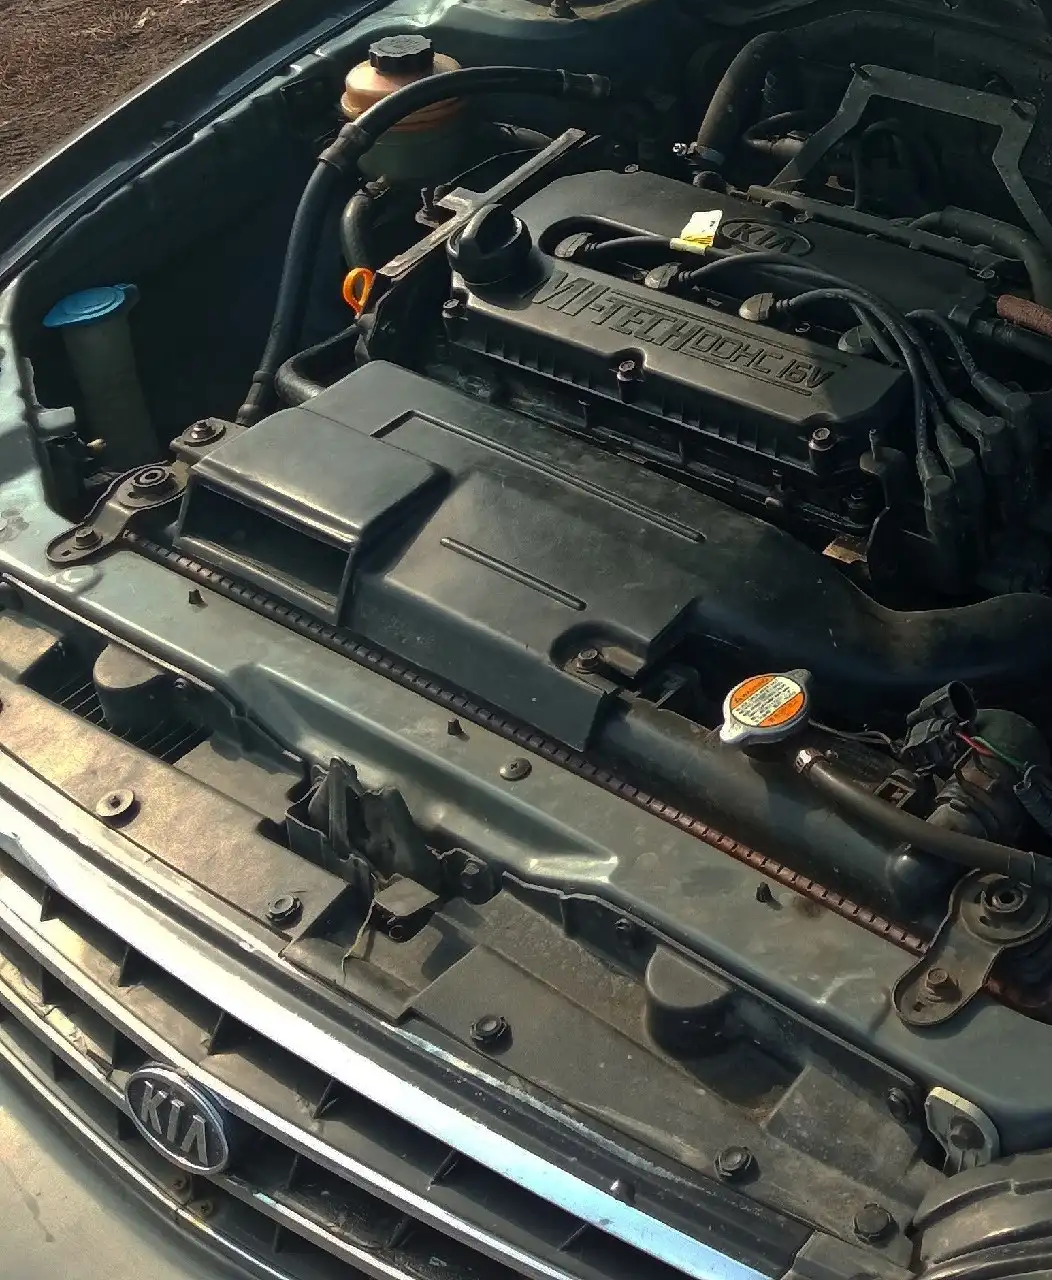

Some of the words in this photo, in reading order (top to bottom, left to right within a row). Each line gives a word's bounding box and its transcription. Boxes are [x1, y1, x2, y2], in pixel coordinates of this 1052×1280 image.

[729, 223, 795, 253] KIA
[690, 327, 784, 374] DOHC
[777, 358, 835, 388] 16V
[141, 1080, 208, 1166] KIA
